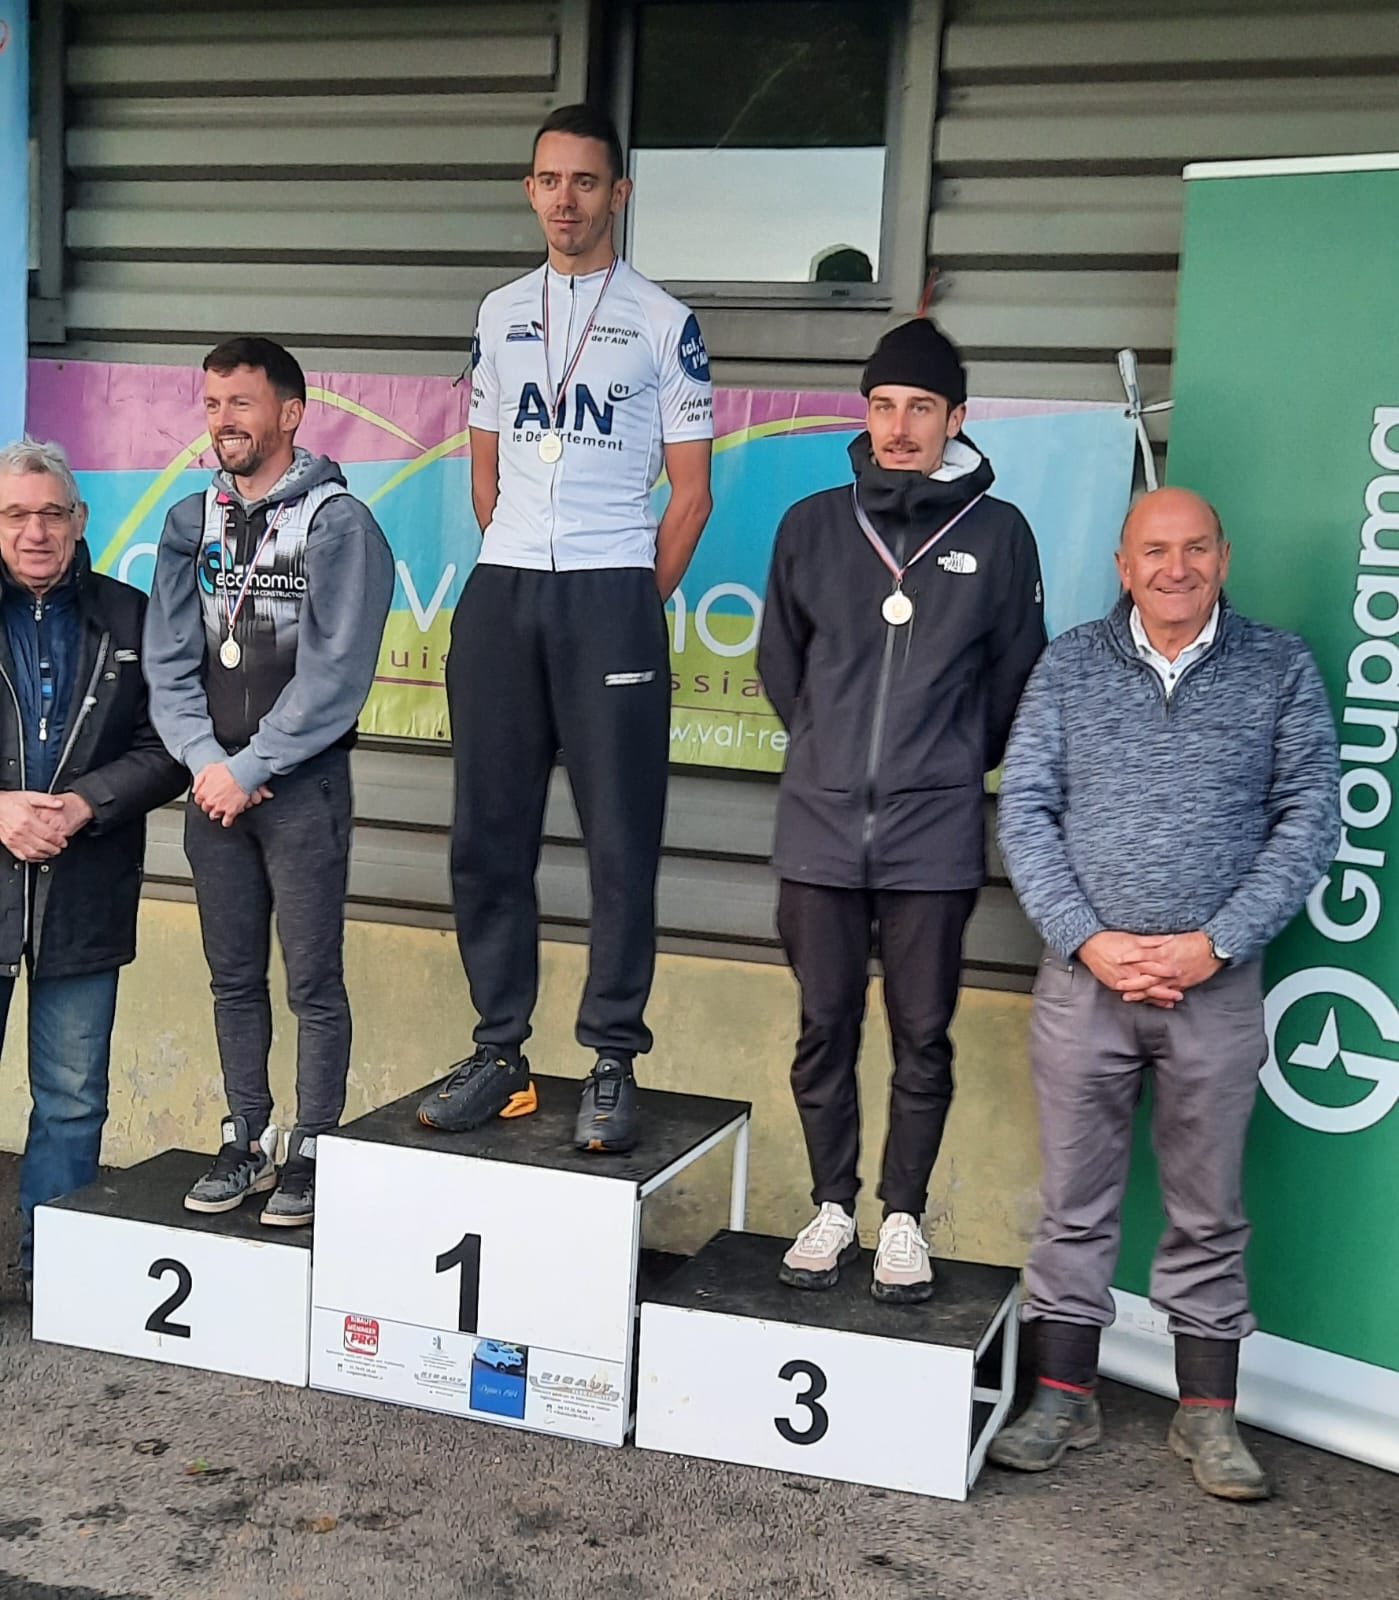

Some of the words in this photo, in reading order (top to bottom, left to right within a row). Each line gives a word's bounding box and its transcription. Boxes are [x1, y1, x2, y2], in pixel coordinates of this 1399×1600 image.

[513, 382, 614, 435] AIN
[614, 383, 631, 396] 01
[512, 432, 524, 443] le
[1306, 405, 1399, 943] Groupama
[145, 1257, 193, 1338] 2
[435, 1233, 482, 1333] 1
[350, 1333, 377, 1346] PRO
[773, 1360, 830, 1444] 3
